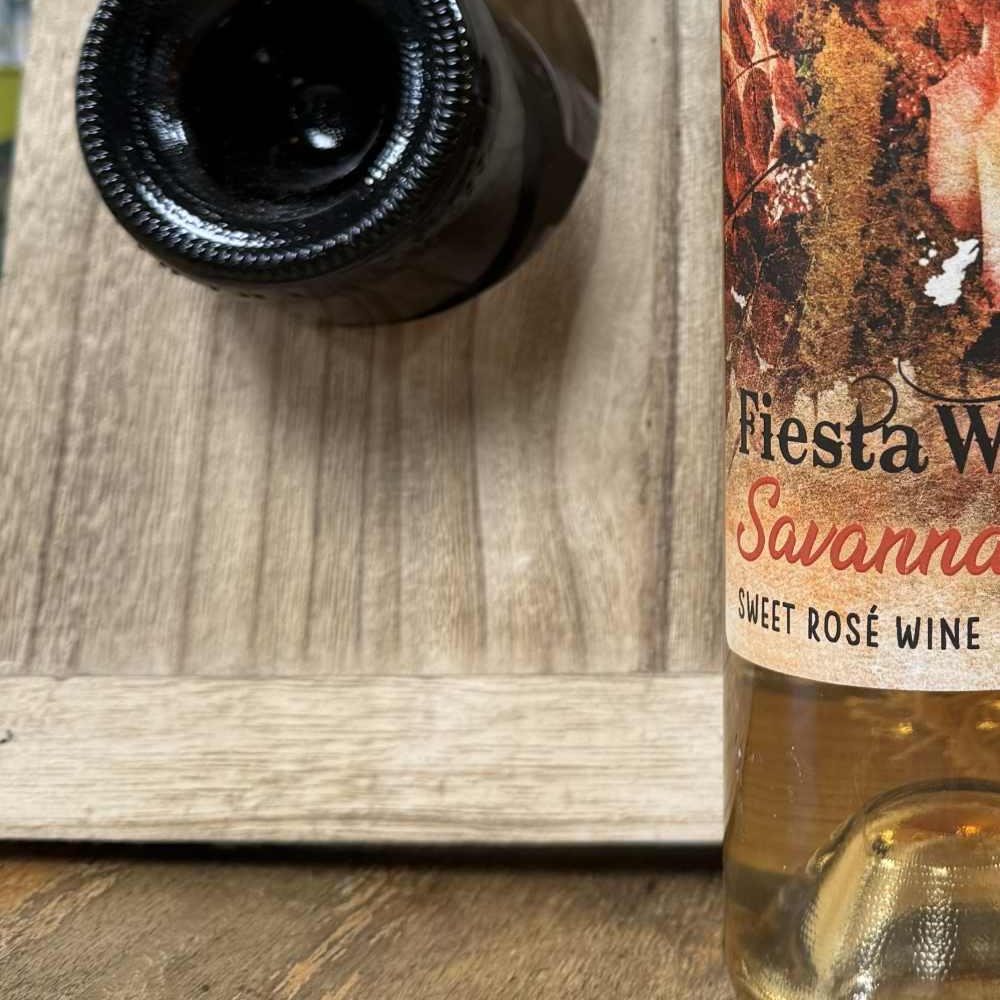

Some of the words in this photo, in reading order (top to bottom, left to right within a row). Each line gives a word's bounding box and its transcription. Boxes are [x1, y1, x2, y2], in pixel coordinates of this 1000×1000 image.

[738, 375, 929, 474] Fiesta
[738, 586, 796, 635] SWEET
[808, 604, 880, 648] ROSÉ
[895, 615, 981, 651] WINE
